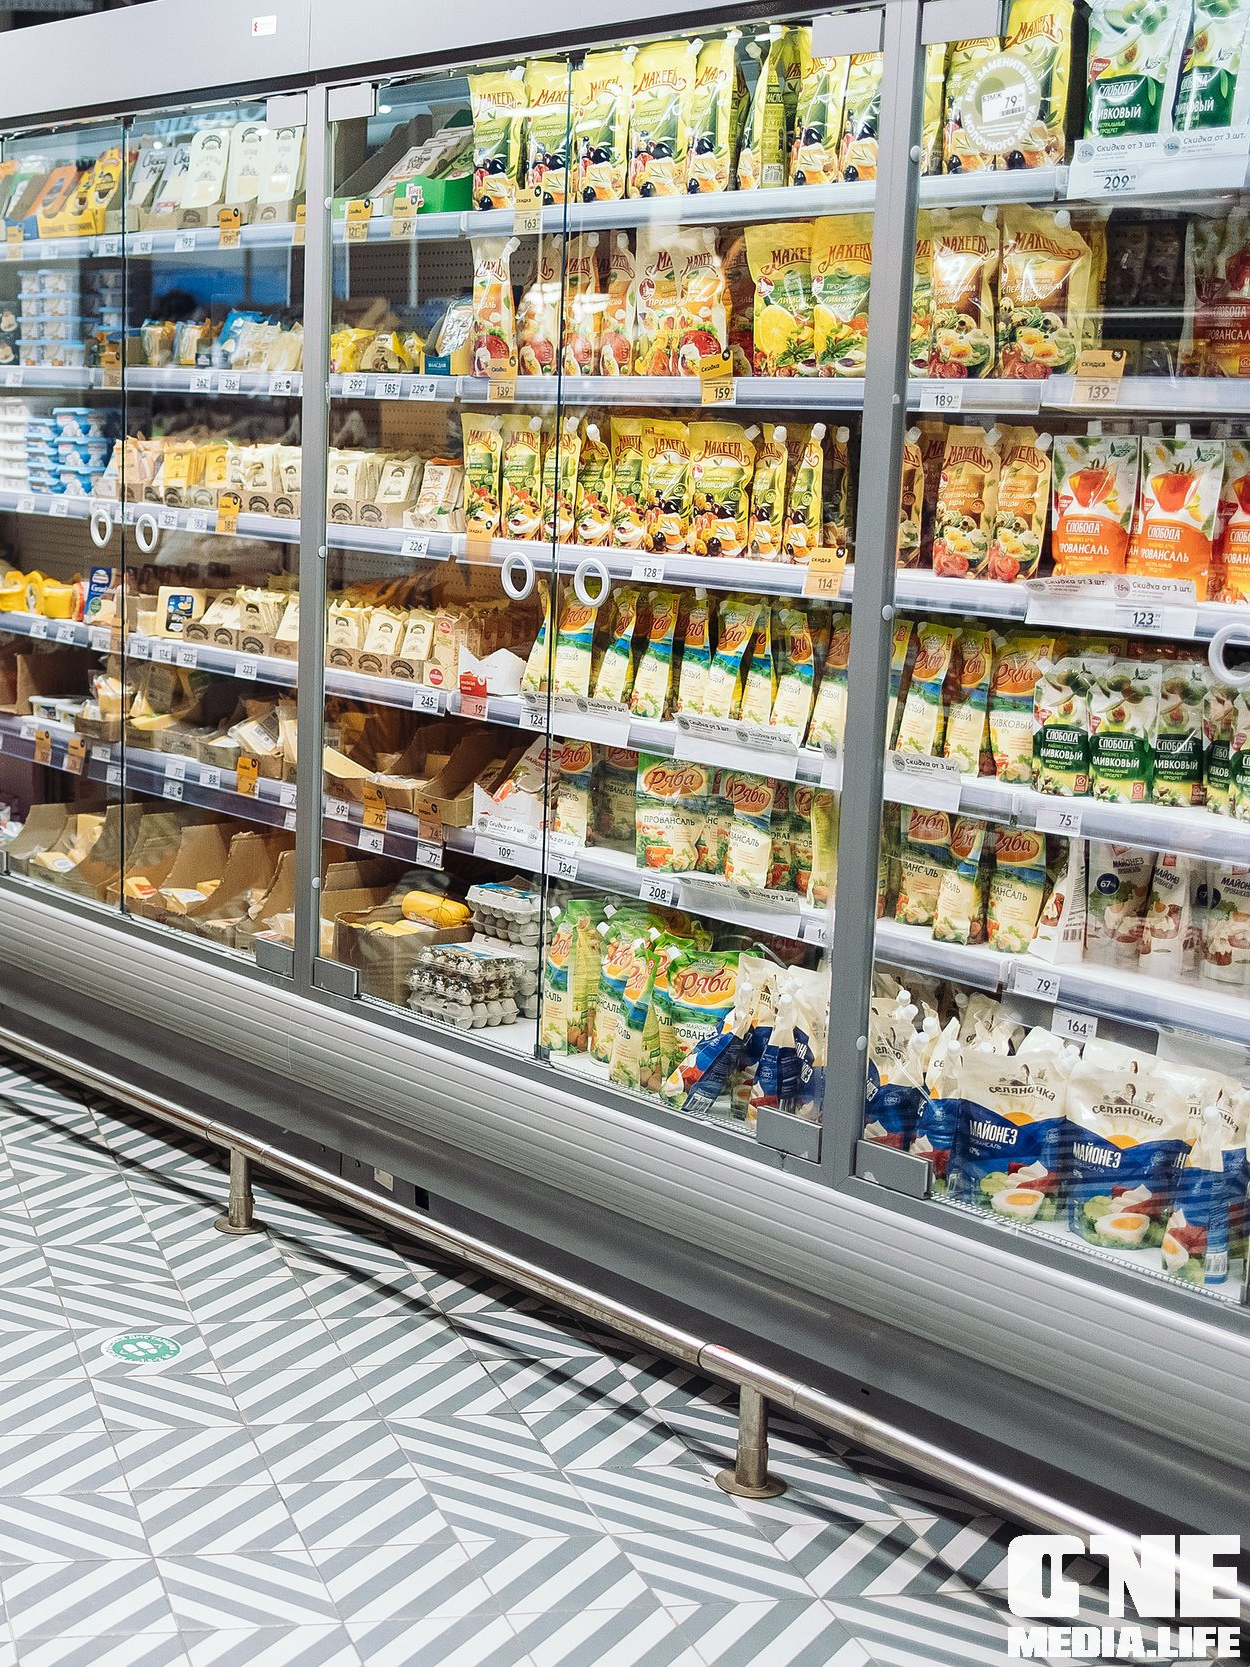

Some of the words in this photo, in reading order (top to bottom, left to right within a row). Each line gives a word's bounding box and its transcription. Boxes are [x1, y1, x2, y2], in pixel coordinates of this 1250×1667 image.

[964, 76, 980, 102] БЕЗ
[1098, 81, 1136, 98] СЛОБОДА
[982, 93, 1003, 103] БЗМЖ
[1088, 104, 1142, 122] ОИВКОВЫЙ
[963, 113, 1015, 152] МОЛОЧНОГО
[1015, 104, 1037, 140] ЖИРА
[1183, 135, 1213, 145] Скидка
[1096, 142, 1125, 152] Скидка
[1103, 175, 1130, 190] 209
[524, 219, 537, 230] 163
[700, 363, 720, 374] Скидка
[1081, 361, 1106, 369] скидка
[496, 387, 510, 397] 139
[714, 387, 730, 399] 159
[1088, 386, 1110, 399] 139
[934, 395, 953, 407] 189
[1065, 521, 1100, 534] СЛОБОДА
[1147, 526, 1181, 540] СЛОБОДА
[643, 568, 657, 577] 128
[818, 579, 833, 589] 114
[1132, 582, 1161, 591] Скидка
[1132, 612, 1155, 625] 123
[421, 696, 434, 706] 245
[530, 715, 543, 726] 124
[1046, 730, 1079, 743] СЛОБОДА
[1099, 738, 1134, 750] СЛОБОДА
[1093, 756, 1140, 768] ОЛИВКОВЫЙ
[1153, 759, 1198, 770] ЛИВКОВЫЙ
[646, 768, 694, 793] Ряба
[644, 816, 695, 826] ПРОВАНСАЛЬ
[1059, 814, 1072, 827] 75
[498, 846, 511, 857] 109
[558, 862, 572, 874] 134
[1221, 877, 1250, 889] МАЙОН
[650, 886, 666, 899] 208
[676, 970, 732, 1000] Ряба
[1037, 978, 1051, 990] 79
[1068, 1019, 1087, 1034] 164
[970, 1119, 1018, 1145] МАЙОНЕЗ
[1073, 1142, 1121, 1168] МАЙОНЕЗ
